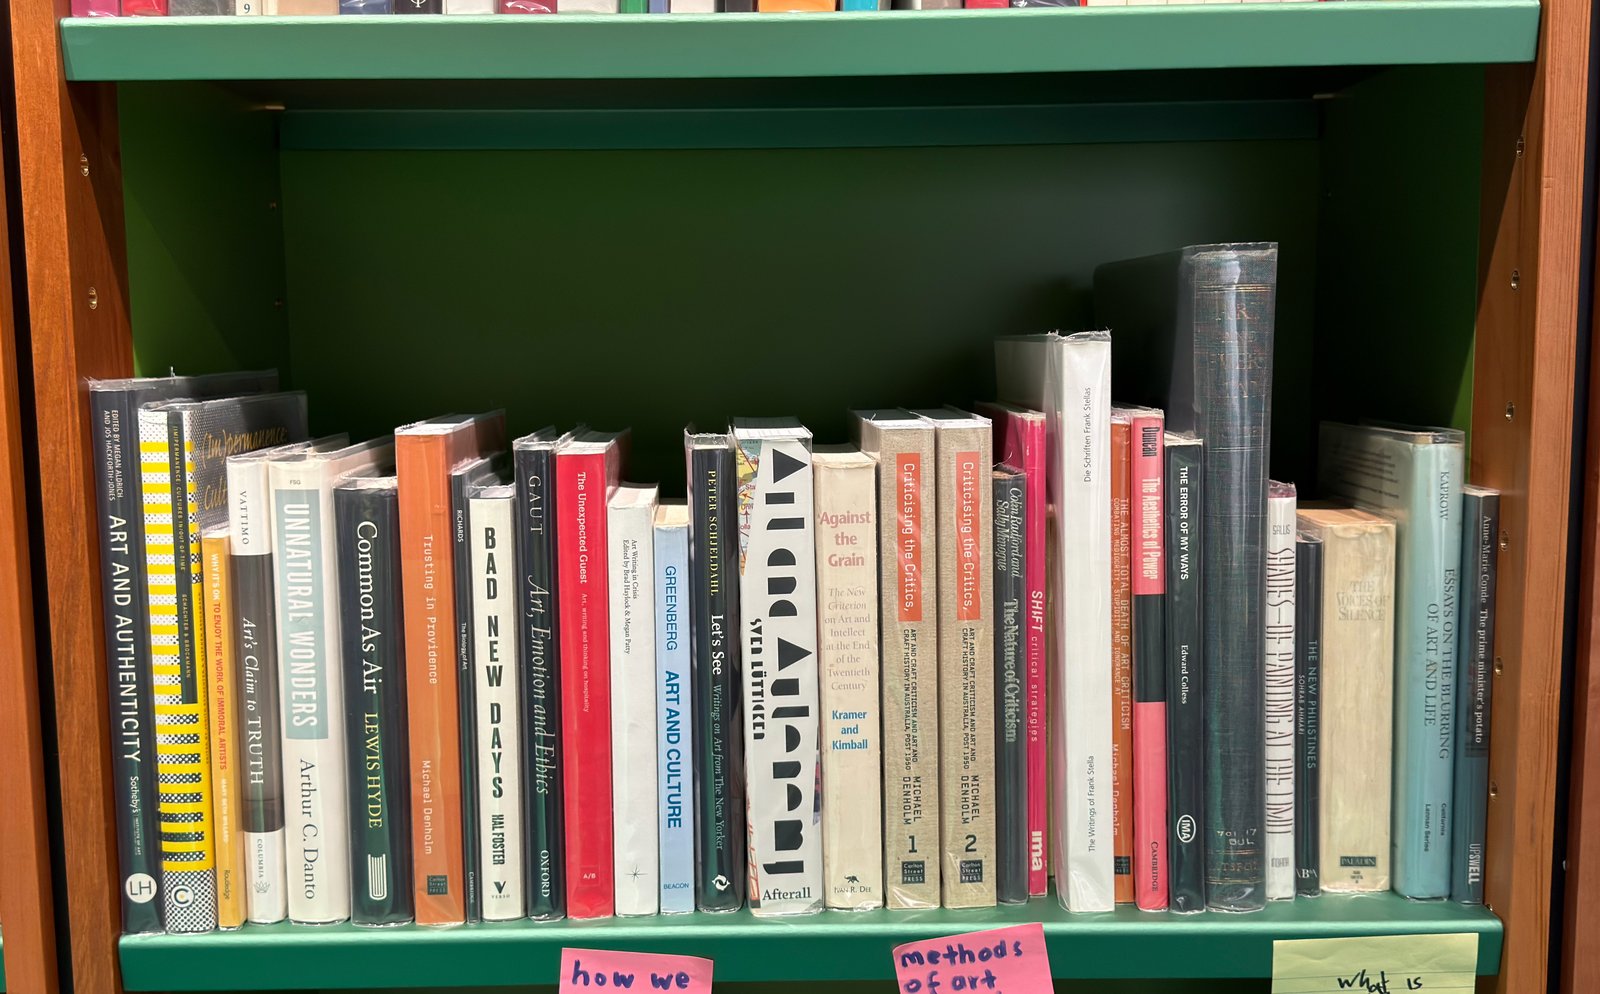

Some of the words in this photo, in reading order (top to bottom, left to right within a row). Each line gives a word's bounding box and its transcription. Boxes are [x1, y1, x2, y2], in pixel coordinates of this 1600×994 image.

[244, 4, 250, 14] 9
[112, 410, 120, 432] EDITED
[113, 434, 120, 442] BY
[114, 444, 122, 463] MEGAN
[1142, 427, 1160, 457] Duncan
[115, 464, 123, 498] ALDRICH
[578, 472, 586, 490] The
[708, 470, 717, 511] PETER
[1142, 477, 1160, 493] The
[1180, 466, 1188, 484] THE
[528, 476, 542, 535] GAUT
[902, 464, 916, 534] Criticising
[961, 462, 974, 533] Criticising
[1009, 488, 1022, 516] Colin
[1180, 487, 1188, 518] ERROR
[1439, 471, 1450, 520] KAPROW
[239, 490, 249, 545] VATTIMO
[577, 493, 587, 551] Unexpected
[820, 512, 871, 528] Against
[995, 500, 1009, 526] Sally
[1142, 495, 1161, 538] Aesthetics
[1180, 521, 1188, 534] OF
[109, 515, 128, 554] ART
[835, 532, 857, 546] the
[904, 539, 916, 559] the
[964, 538, 975, 558] the
[994, 527, 1010, 571] Minogue
[1009, 516, 1023, 555] Radford
[1143, 541, 1160, 549] of
[1181, 537, 1189, 551] MY
[1481, 516, 1492, 572] Anne-Marie
[284, 504, 314, 622] UNNATURAL
[357, 521, 378, 621] Common
[423, 536, 435, 589] Trusting
[485, 527, 498, 600] BAD
[579, 555, 588, 584] Guest
[709, 516, 719, 596] SCHJELDAHL
[828, 554, 865, 568] Grain
[1011, 556, 1023, 578] and
[1143, 551, 1160, 579] Power
[1181, 554, 1189, 580] WAYS
[113, 562, 131, 606] AND
[526, 575, 550, 618] Art,
[904, 563, 916, 612] Critics,
[963, 562, 975, 610] Critics,
[1350, 581, 1374, 592] THE
[1443, 568, 1455, 617] ESSAYS
[1480, 574, 1489, 603] Conde
[426, 597, 435, 609] in
[665, 566, 678, 650] GREENBERG
[1004, 599, 1019, 624] The
[1031, 590, 1042, 632] SHIFT
[1338, 607, 1385, 620] SILENCE
[1427, 604, 1439, 622] OF
[1479, 609, 1488, 628] The
[243, 618, 257, 648] Art's
[362, 625, 381, 652] As
[711, 615, 724, 646] Let's
[750, 618, 763, 655] SVEN
[830, 628, 864, 637] Intellect
[1426, 626, 1438, 655] ART
[1442, 621, 1453, 644] ON
[1477, 630, 1488, 658] prime
[427, 617, 438, 684] Providence
[486, 615, 503, 687] NEW
[531, 624, 552, 698] Emotion
[1004, 625, 1019, 670] Nature
[1181, 645, 1189, 674] Edward
[1308, 640, 1317, 660] THE
[245, 655, 260, 693] Claim
[289, 630, 318, 726] WONDERS
[362, 659, 383, 694] Air
[712, 652, 725, 675] See
[828, 667, 870, 677] Twentieth
[1004, 670, 1020, 683] of
[1425, 659, 1437, 690] AND
[1441, 648, 1452, 680] THE
[116, 614, 140, 762] AUTHENTICITY
[665, 670, 680, 704] ART
[1181, 676, 1189, 704] Colless
[1266, 652, 1294, 723] PAINTING
[1308, 666, 1317, 694] NEW
[1475, 662, 1487, 709] minister's
[247, 700, 257, 711] to
[711, 684, 722, 721] Writings
[751, 661, 767, 740] LÜTTICKEN
[832, 710, 867, 720] Kramer
[1004, 683, 1020, 743] Criticism
[1029, 684, 1038, 742] strategies
[1424, 695, 1436, 726] LIFE
[534, 704, 555, 737] and
[666, 707, 681, 744] AND
[714, 723, 720, 734] on
[840, 724, 858, 734] and
[1307, 700, 1317, 769] PHILISTINES
[1439, 684, 1451, 759] BLURRING
[1474, 712, 1484, 743] potato
[248, 716, 264, 785] TRUTH
[364, 712, 381, 770] LEWIS
[490, 703, 503, 798] DAYS
[714, 737, 722, 751] Art
[832, 739, 868, 750] Kimball
[1266, 730, 1294, 748] AT
[535, 742, 556, 795] Ethics
[712, 753, 724, 774] from
[1266, 758, 1294, 786] THE
[130, 776, 141, 813] Sotheby's
[300, 759, 316, 817] Arthur
[422, 760, 431, 803] Michael
[667, 749, 682, 828] CULTURE
[715, 776, 724, 792] The
[367, 776, 382, 828] HYDE
[715, 797, 724, 817] New
[902, 776, 911, 825] DENHOLM
[913, 776, 921, 822] MICHAEL
[961, 776, 969, 824] DENHOLM
[971, 775, 980, 821] MICHAEL
[1266, 793, 1294, 834] LIMIT
[302, 824, 318, 842] C.
[423, 808, 433, 854] Denholm
[492, 814, 504, 830] HAL
[716, 820, 725, 850] Yorker
[1182, 819, 1191, 839] IMA
[492, 833, 505, 865] FOSTER
[908, 835, 917, 853] 1
[965, 834, 977, 852] 2
[1032, 831, 1042, 871] ima
[303, 848, 319, 899] Danto
[540, 850, 550, 897] OXFORD
[1468, 843, 1481, 885] UPSWELL
[762, 887, 811, 900] Afterall
[901, 940, 1023, 968] methods
[572, 959, 634, 988] how
[651, 971, 689, 990] we
[904, 970, 940, 994] of
[952, 969, 997, 991] art
[1407, 976, 1422, 990] is
